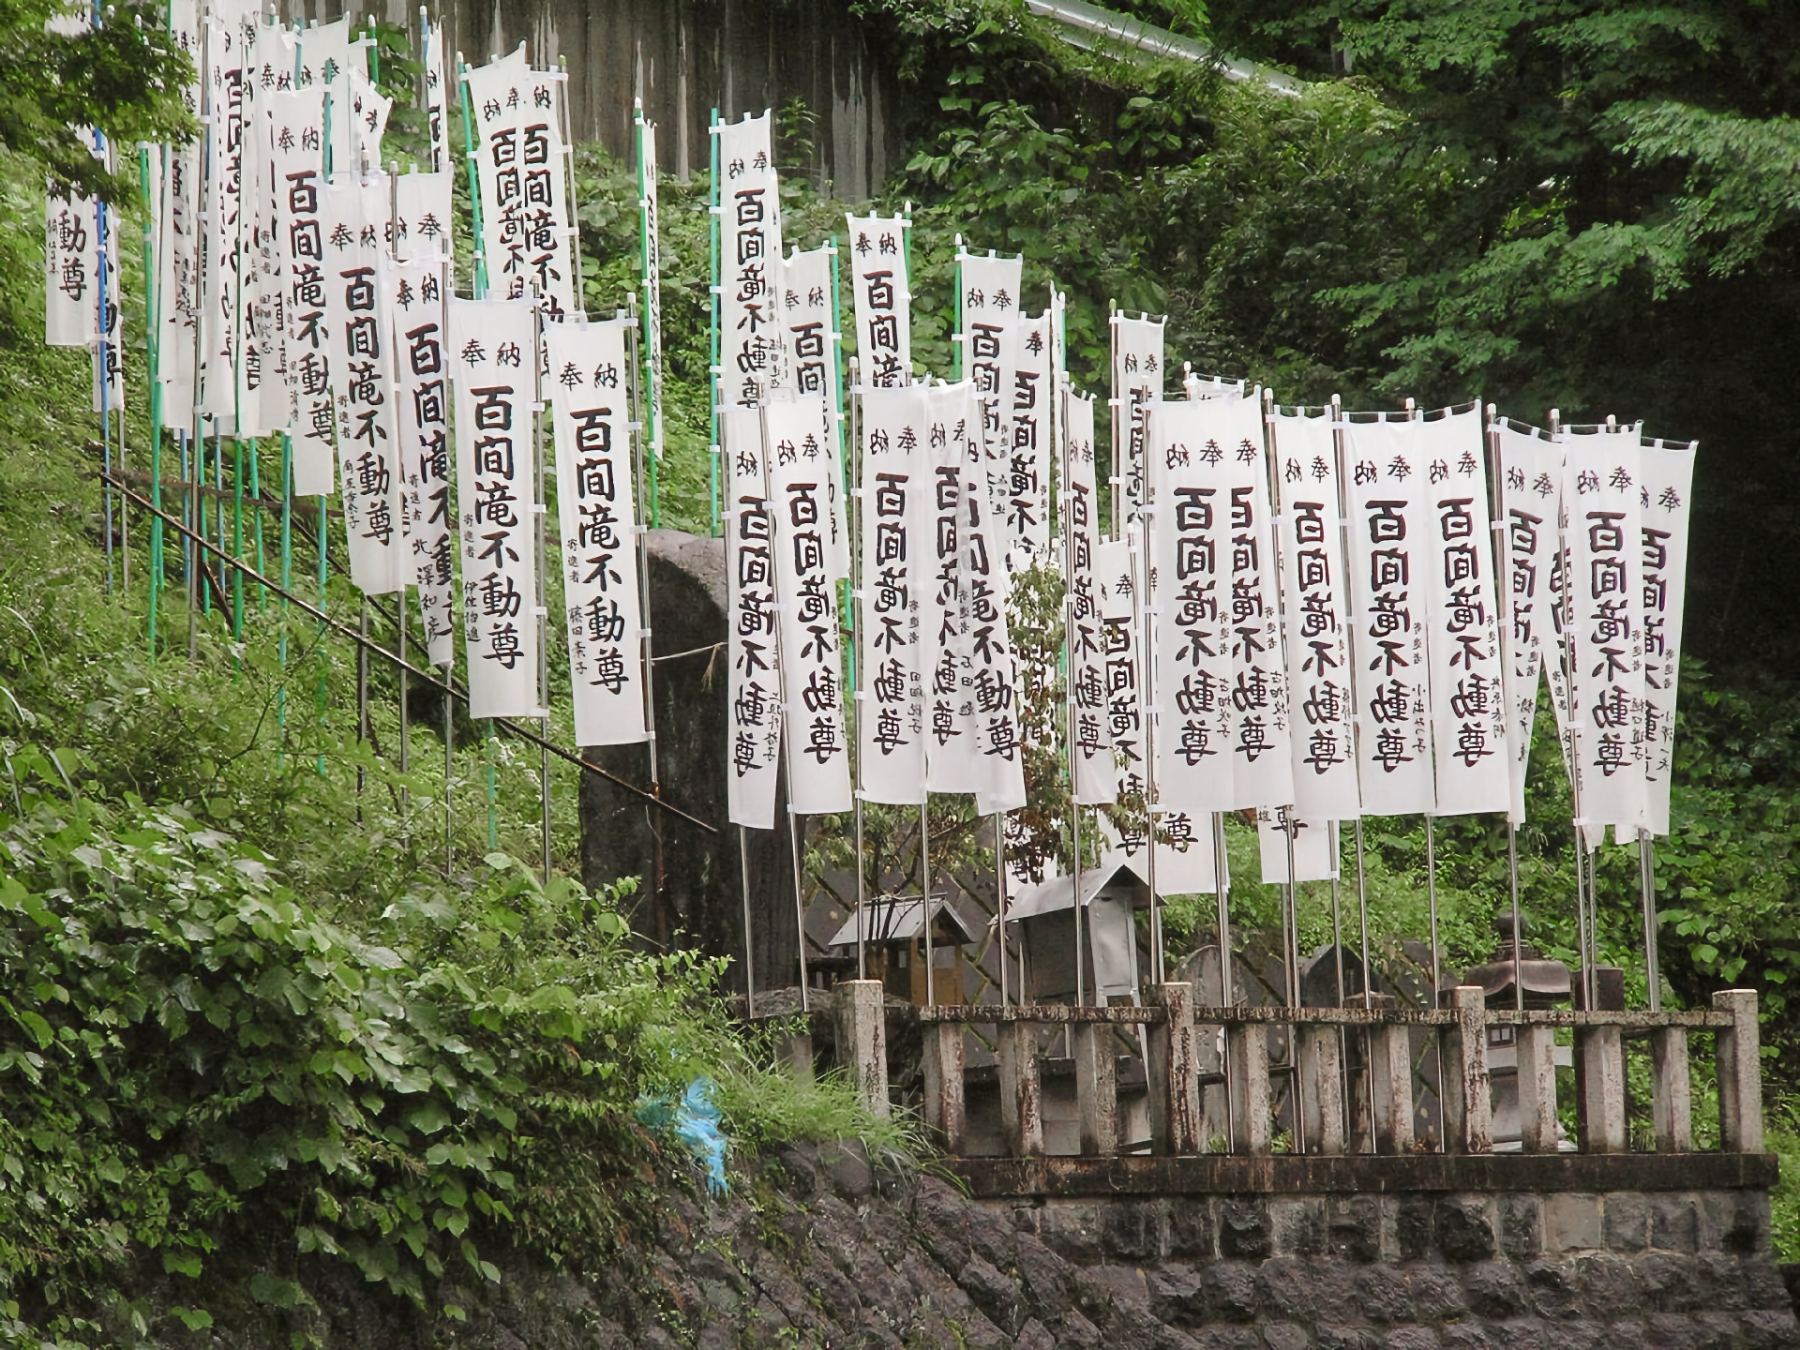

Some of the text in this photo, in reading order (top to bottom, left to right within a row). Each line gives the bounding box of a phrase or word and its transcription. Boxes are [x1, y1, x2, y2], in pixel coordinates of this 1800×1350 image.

[278, 126, 319, 155] 奉納
[329, 222, 377, 252] 奉納
[855, 231, 897, 258] 奉納
[285, 170, 333, 446] 百間滝不動尊
[397, 272, 440, 312] 奉納
[461, 338, 522, 369] 奉納
[560, 362, 617, 393] 奉納
[340, 267, 394, 546] 百間滝不動尊
[470, 386, 524, 669] 百間滝不動尊
[570, 407, 629, 695] 百間滝不動尊
